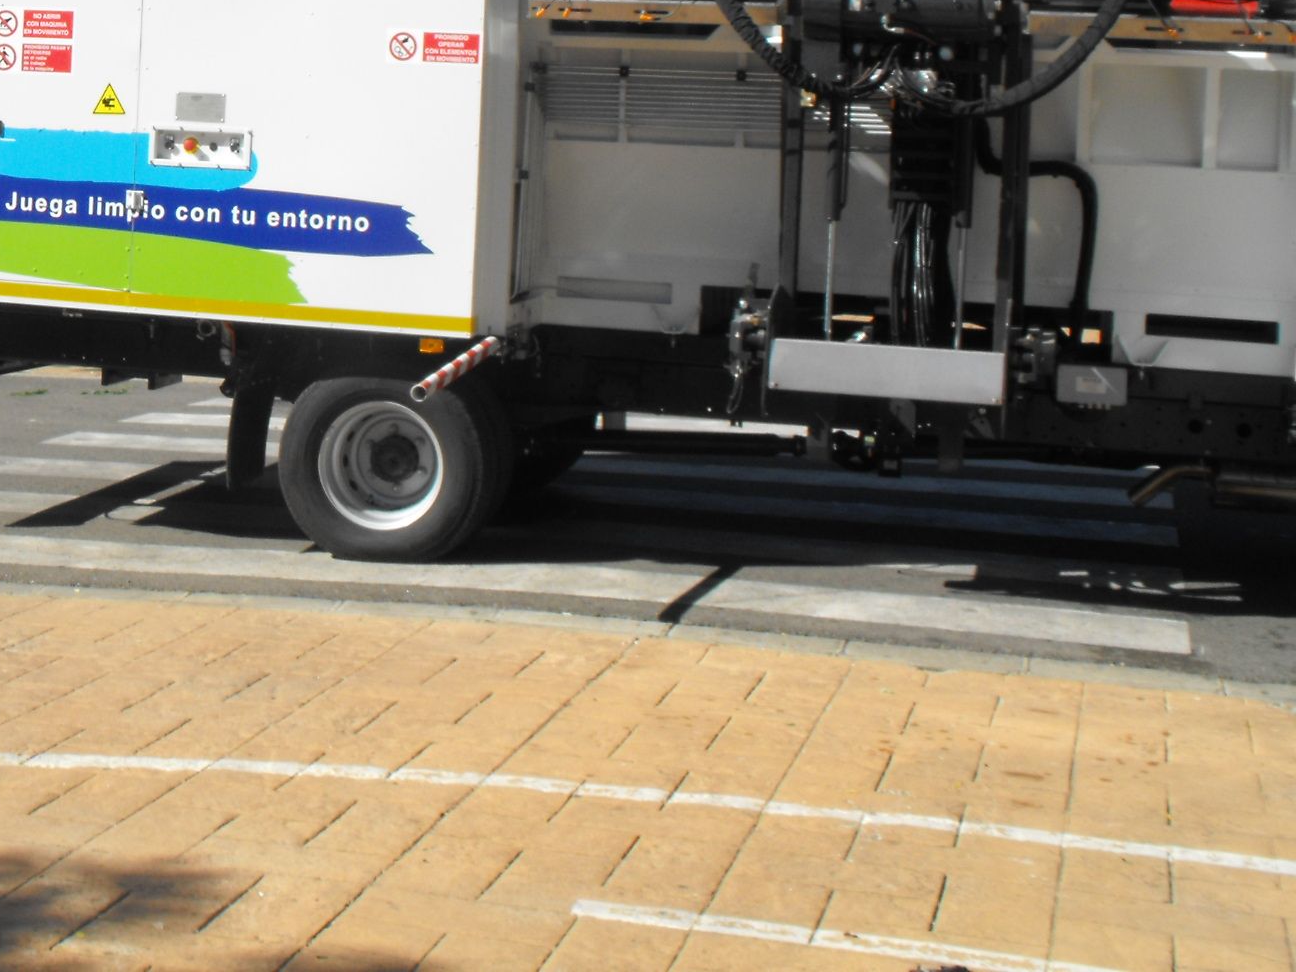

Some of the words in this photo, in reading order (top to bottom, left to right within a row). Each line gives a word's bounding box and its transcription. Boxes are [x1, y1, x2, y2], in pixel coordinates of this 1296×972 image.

[33, 28, 69, 36] MOVIMIENTO
[5, 191, 77, 218] Juega
[175, 206, 221, 223] con
[231, 205, 256, 225] tu
[267, 209, 370, 232] entorno
